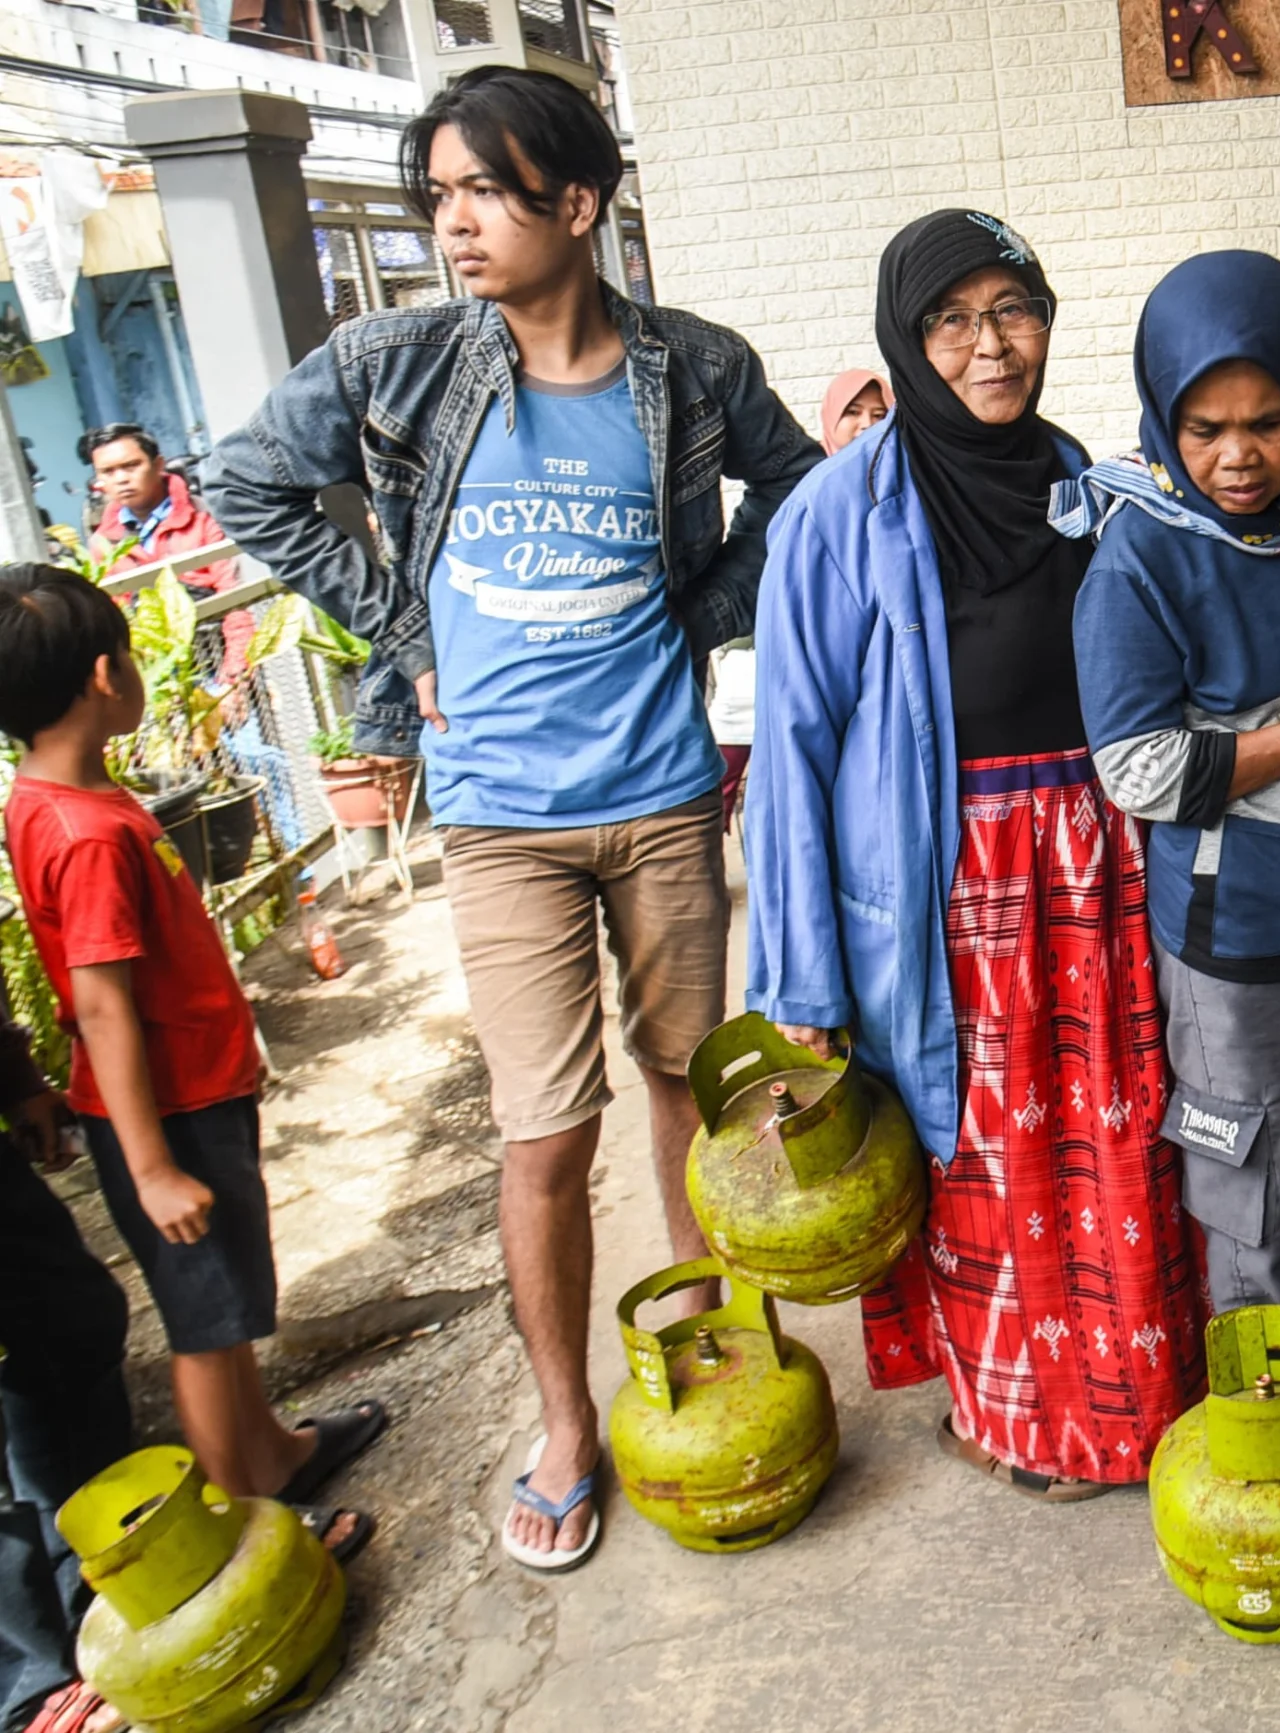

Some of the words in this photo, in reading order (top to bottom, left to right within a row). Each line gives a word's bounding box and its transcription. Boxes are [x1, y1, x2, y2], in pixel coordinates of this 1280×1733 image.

[543, 457, 589, 476] THE
[513, 479, 581, 496] CULTURE
[584, 485, 618, 498] CITY
[446, 498, 663, 545] OGYAKART
[502, 541, 628, 582] Vintage
[488, 595, 558, 613] ORIGINAL
[598, 588, 644, 608] UNITED
[1180, 1101, 1240, 1149] THRASHER
